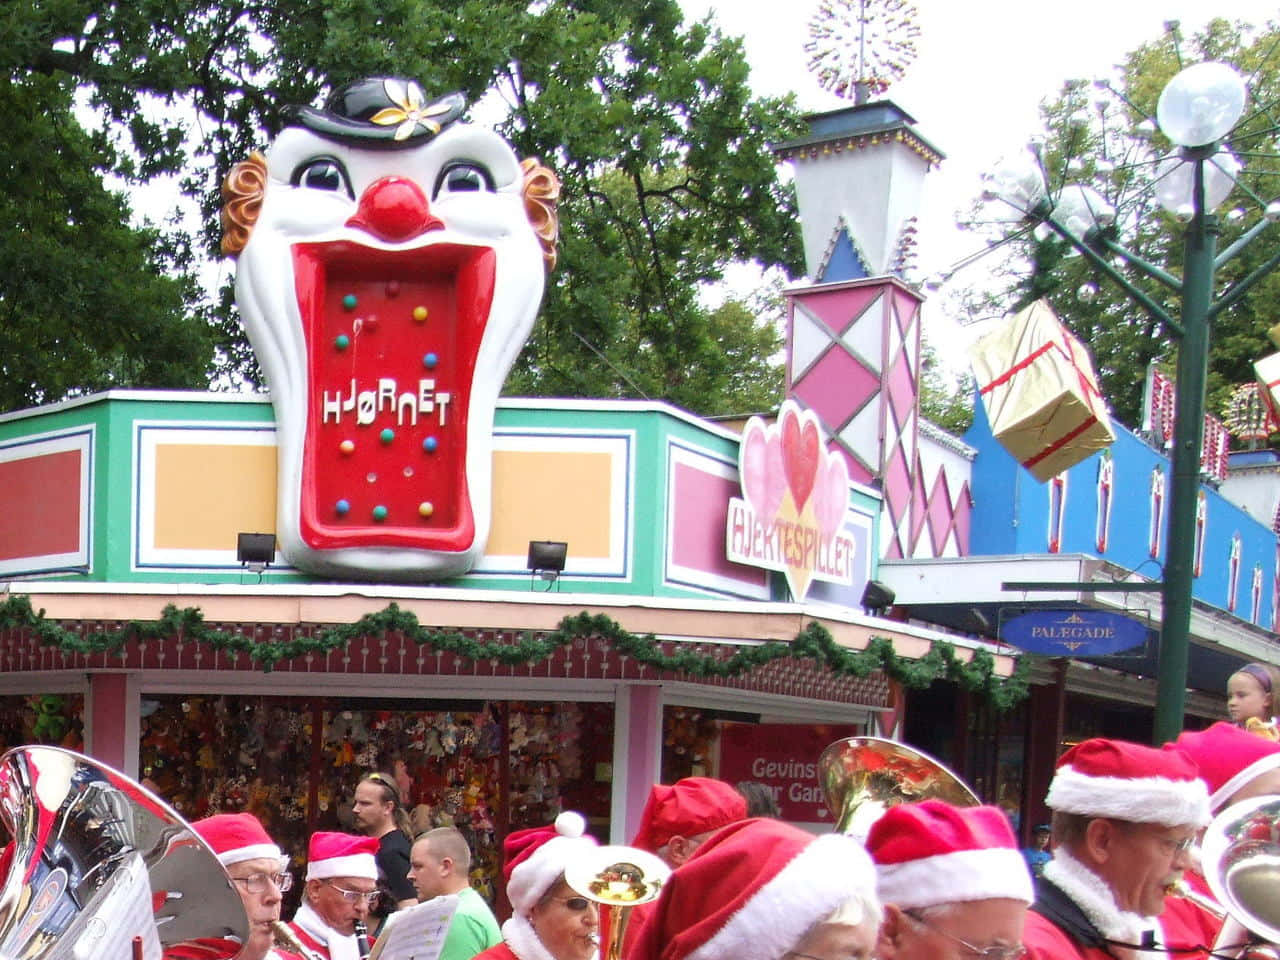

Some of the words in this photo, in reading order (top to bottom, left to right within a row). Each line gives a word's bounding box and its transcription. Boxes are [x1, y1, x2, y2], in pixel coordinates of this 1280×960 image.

[323, 378, 450, 426] HJØRNET
[1031, 626, 1115, 639] PALÆGADE
[752, 757, 820, 779] Gevins
